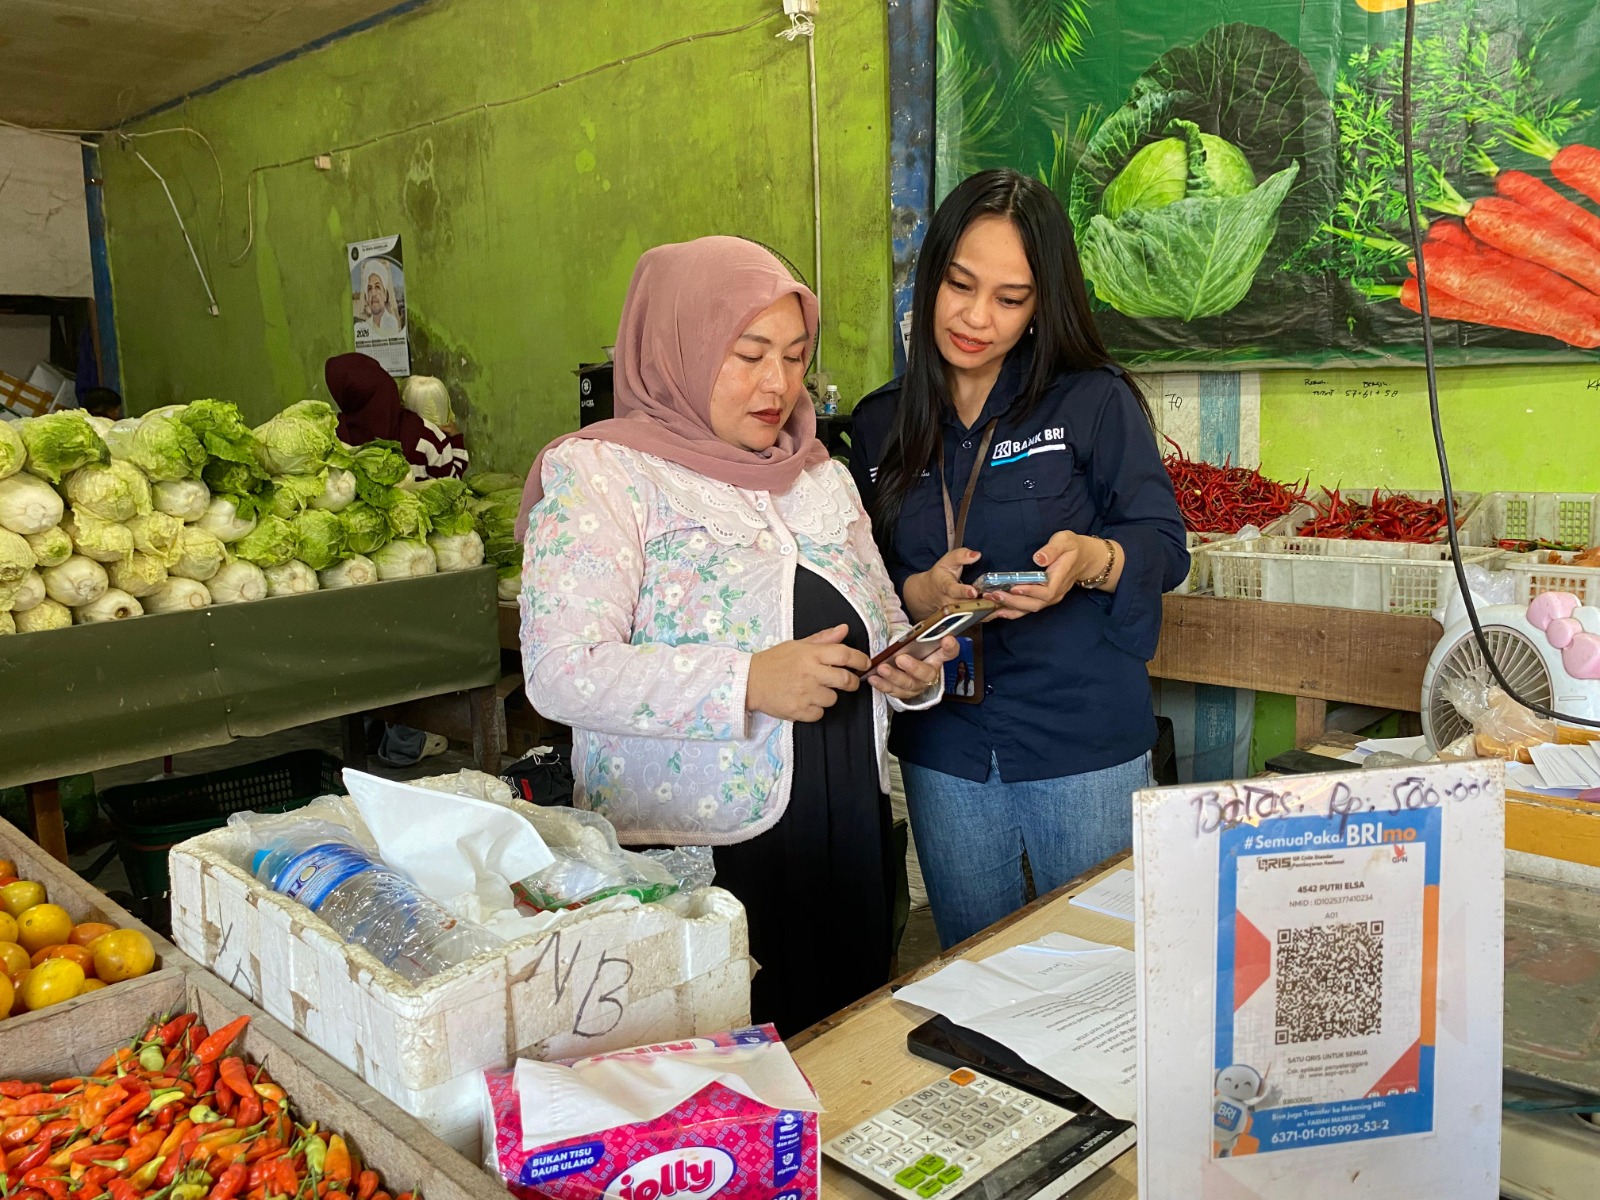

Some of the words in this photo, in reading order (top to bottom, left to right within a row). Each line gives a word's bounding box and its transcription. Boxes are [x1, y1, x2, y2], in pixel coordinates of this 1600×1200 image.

[1012, 432, 1042, 453] BANK
[1044, 427, 1065, 441] BRI
[1256, 856, 1293, 872] QRIS
[1297, 885, 1318, 894] 4542
[1319, 884, 1343, 892] PUTRI
[1345, 881, 1365, 889] ELSA
[1289, 900, 1309, 908] NMID
[1287, 1056, 1305, 1064] SATU
[1305, 1054, 1321, 1062] QRIS
[1322, 1052, 1344, 1060] UNTUK
[1345, 1050, 1368, 1058] SEMUA
[917, 1091, 934, 1100] 00
[940, 1102, 951, 1110] 2
[1303, 1107, 1331, 1117] Transfer
[1341, 1103, 1372, 1113] Rekening
[921, 1112, 933, 1120] 3
[961, 1111, 973, 1119] 5
[1002, 1110, 1014, 1119] 7
[982, 1122, 995, 1130] 8
[1271, 1119, 1390, 1144] 6371-01-015992-53-2
[966, 1133, 977, 1141] 9
[532, 1152, 568, 1167] BUKAN
[569, 1147, 593, 1160] TISU
[530, 1163, 559, 1179] DAUR
[560, 1156, 595, 1171] ULANG
[618, 1158, 716, 1200] jolly
